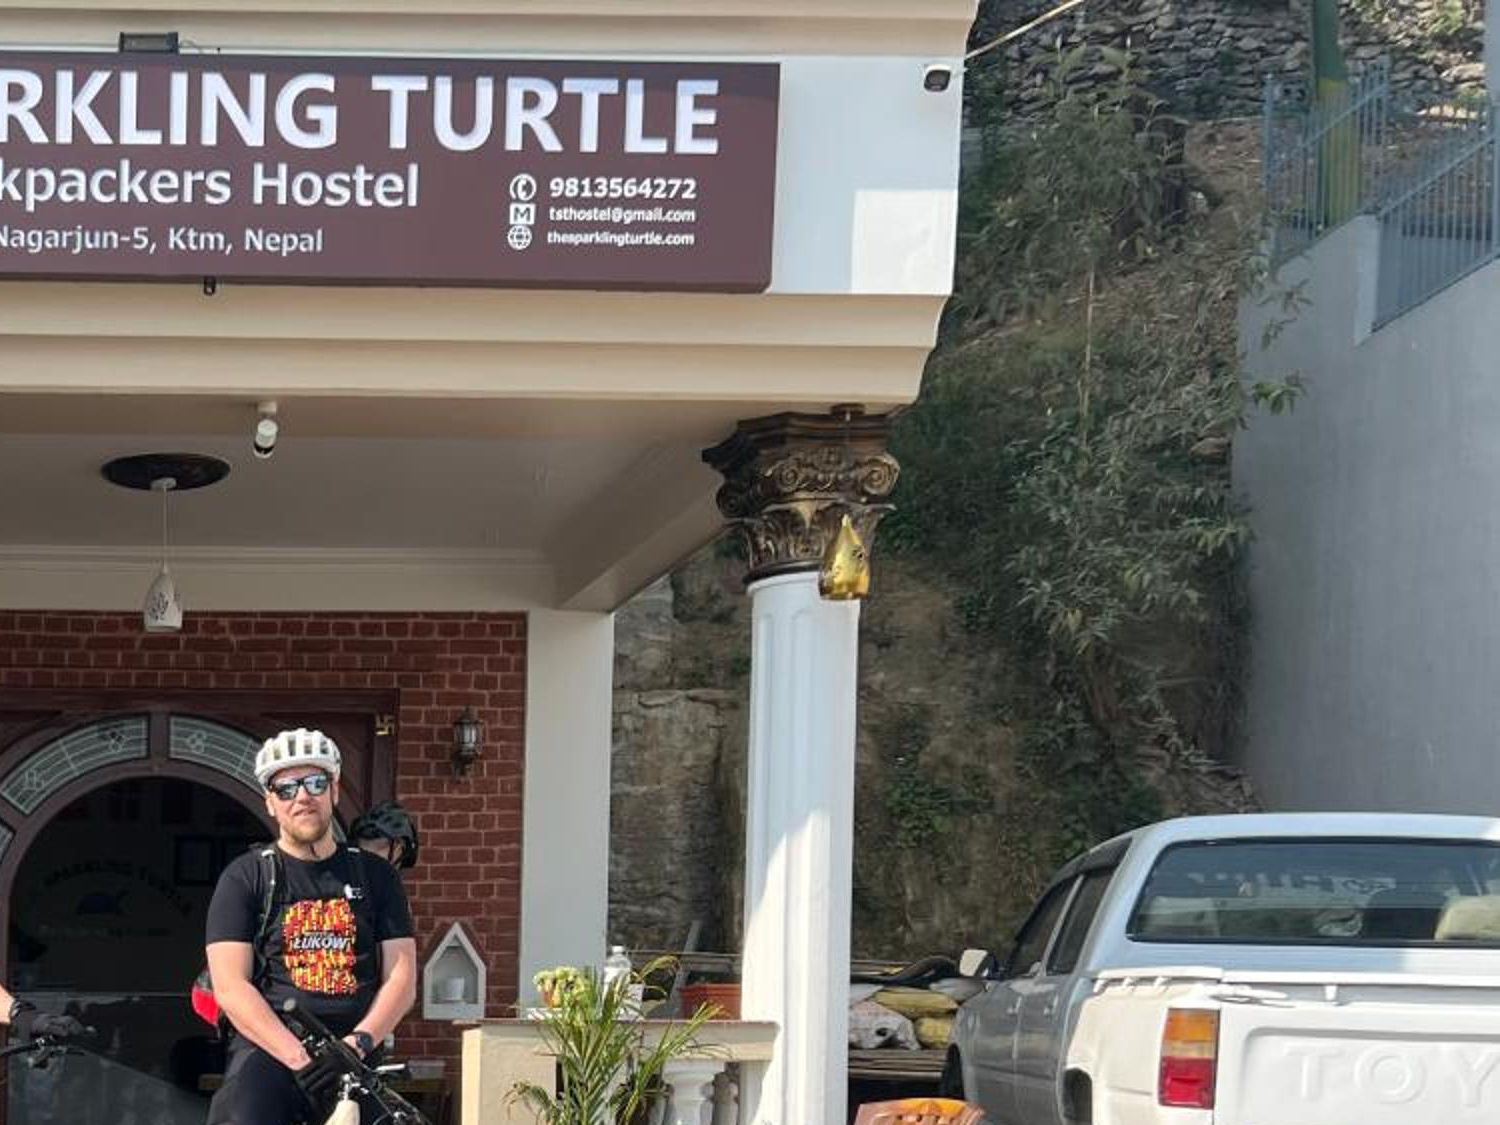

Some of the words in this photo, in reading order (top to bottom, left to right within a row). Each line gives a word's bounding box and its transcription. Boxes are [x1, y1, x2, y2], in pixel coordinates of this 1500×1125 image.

[371, 76, 718, 155] TURTLE
[252, 163, 418, 208] Hostel
[549, 176, 697, 200] 9813564272
[549, 206, 696, 225] tsthostel@gmail.com
[168, 226, 233, 256] Ktm,
[244, 228, 323, 257] Nepal
[547, 230, 695, 248] thesparklingturtle.com
